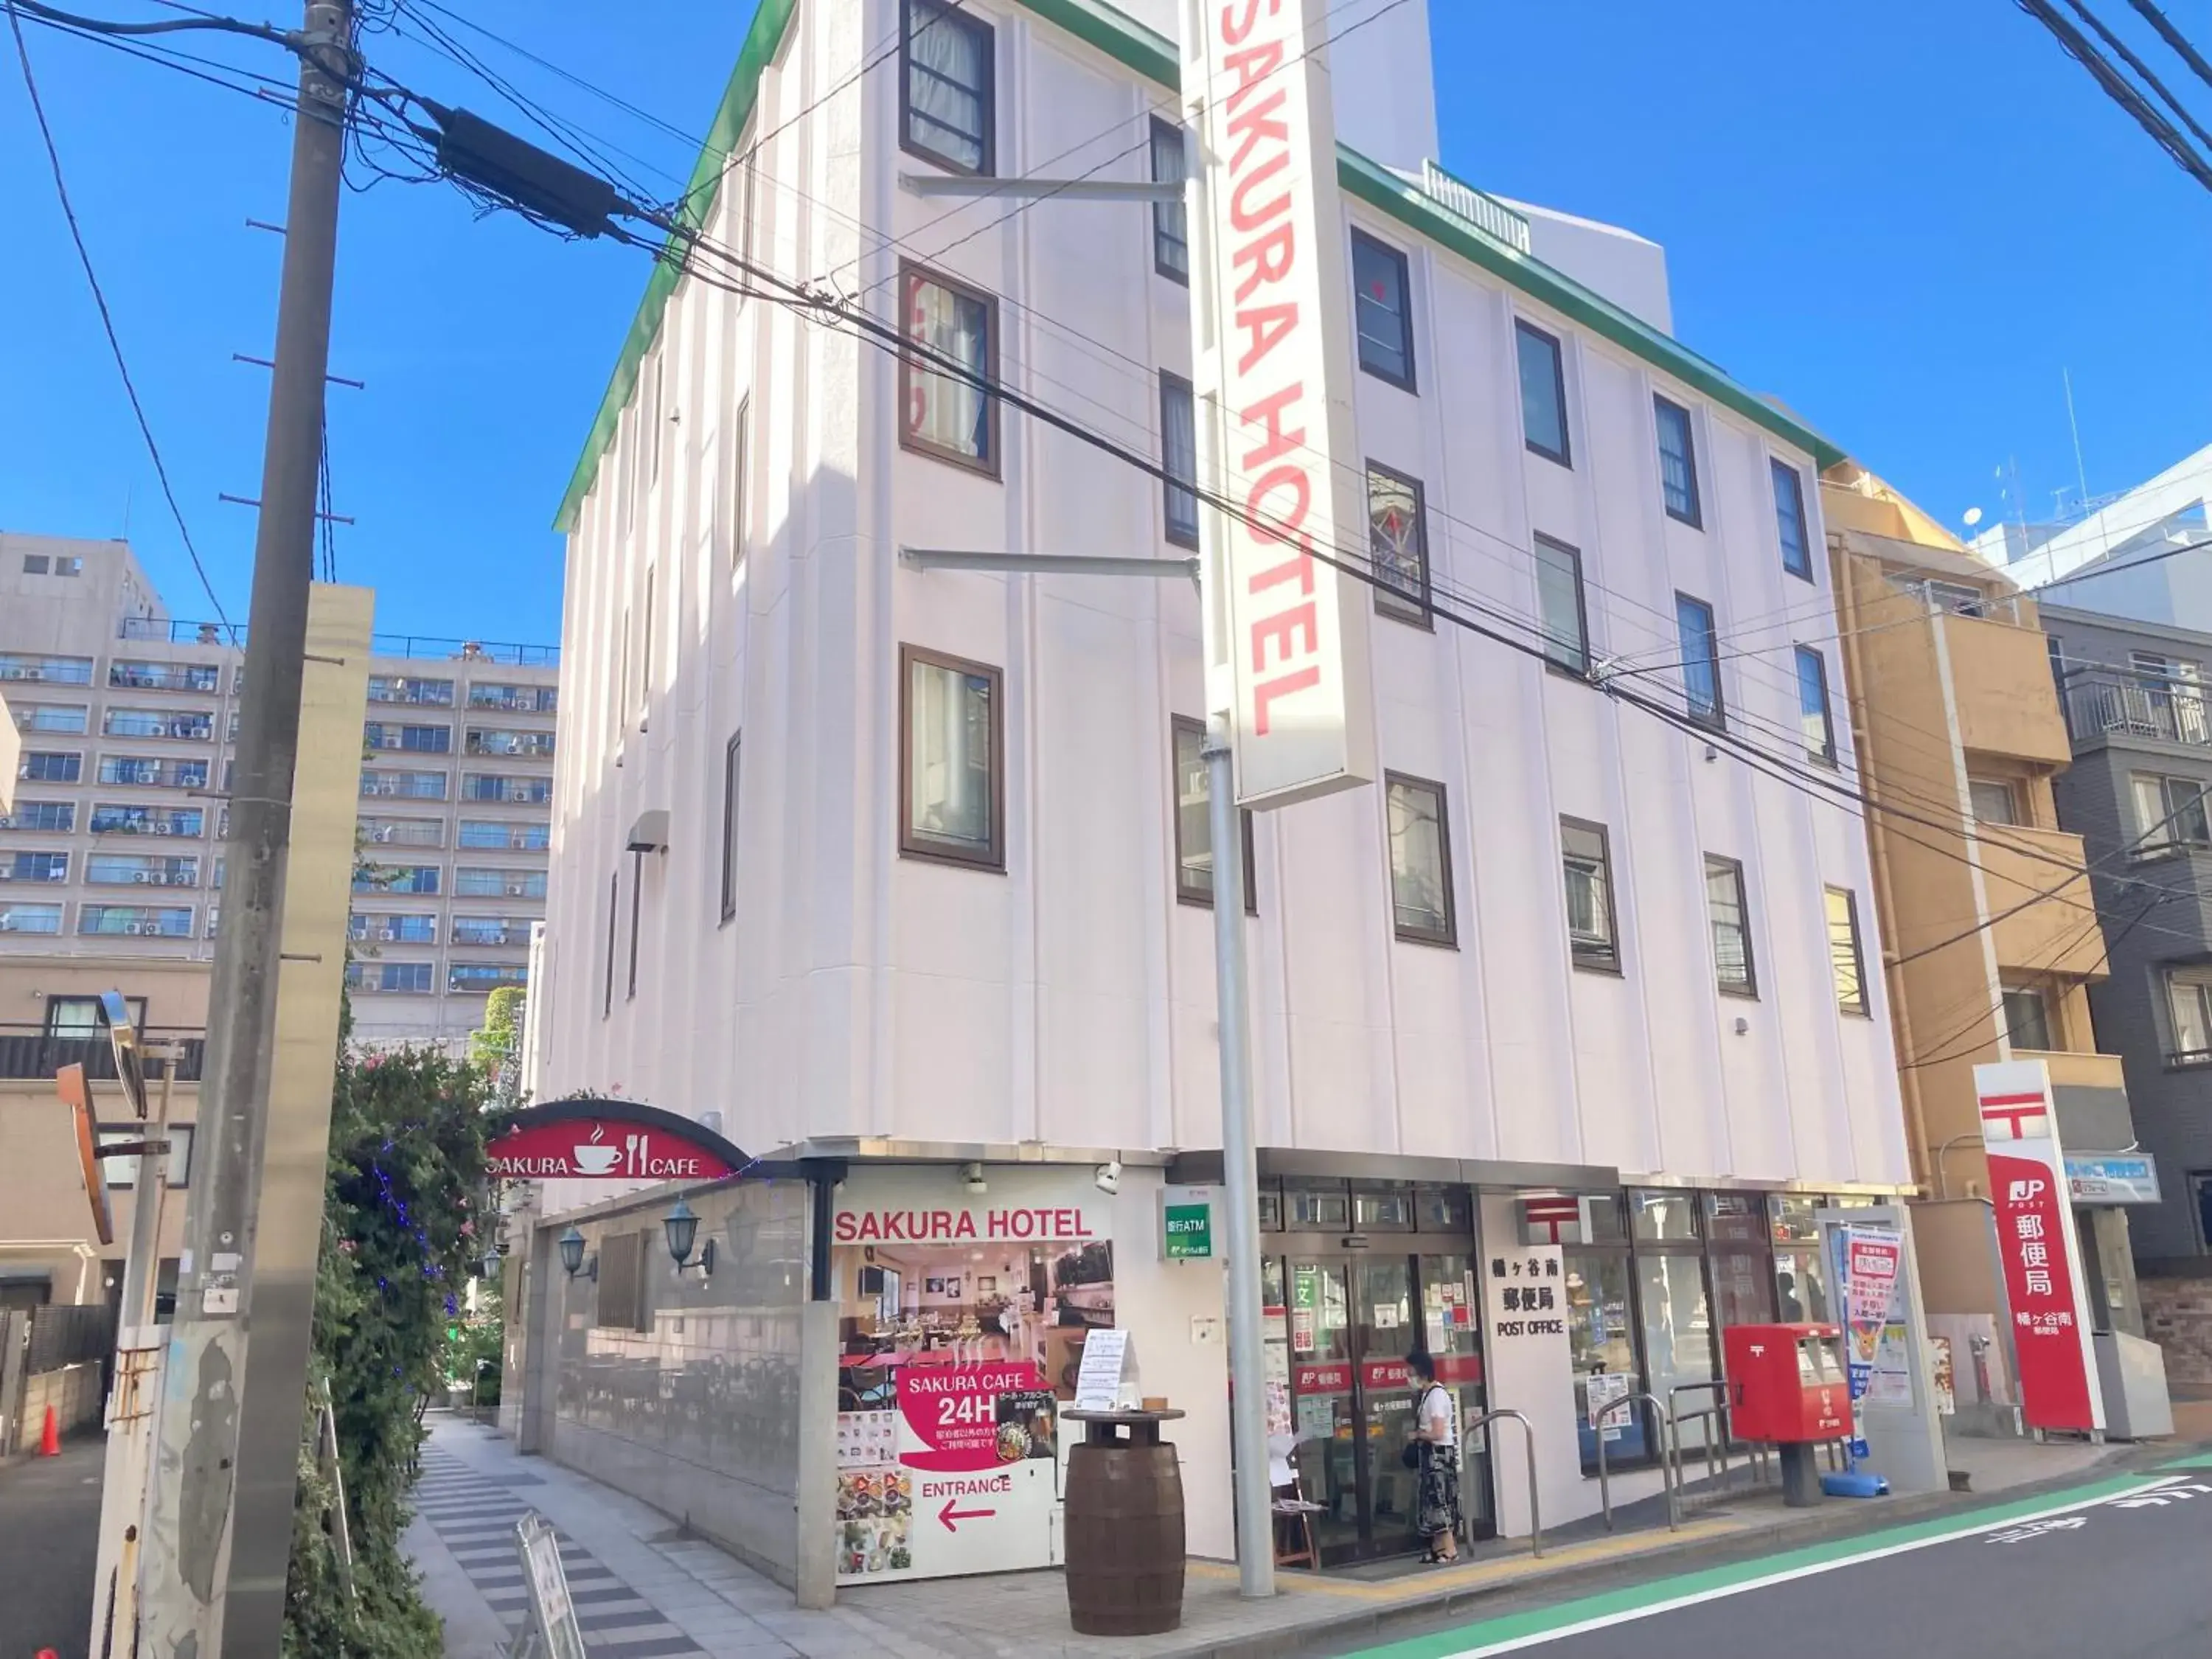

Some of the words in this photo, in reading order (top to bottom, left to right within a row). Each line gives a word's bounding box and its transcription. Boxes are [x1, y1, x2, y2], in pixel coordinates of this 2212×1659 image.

[1221, 0, 1299, 378] SAKURA
[1239, 380, 1321, 737] HOTEL
[484, 1157, 568, 1174] SAKURA
[650, 1158, 699, 1175] CAFE
[835, 1209, 977, 1241] SAKURA
[988, 1208, 1092, 1238] HOTEL
[2015, 1214, 2053, 1296] 郵便局
[1502, 1287, 1554, 1311] 郵便局
[1497, 1321, 1525, 1336] POST
[1528, 1319, 1564, 1335] OFFICE
[909, 1375, 978, 1393] SAKURA
[983, 1372, 1024, 1390] CAFE
[938, 1394, 996, 1425] 24H
[922, 1477, 1012, 1498] ENTRANCE
